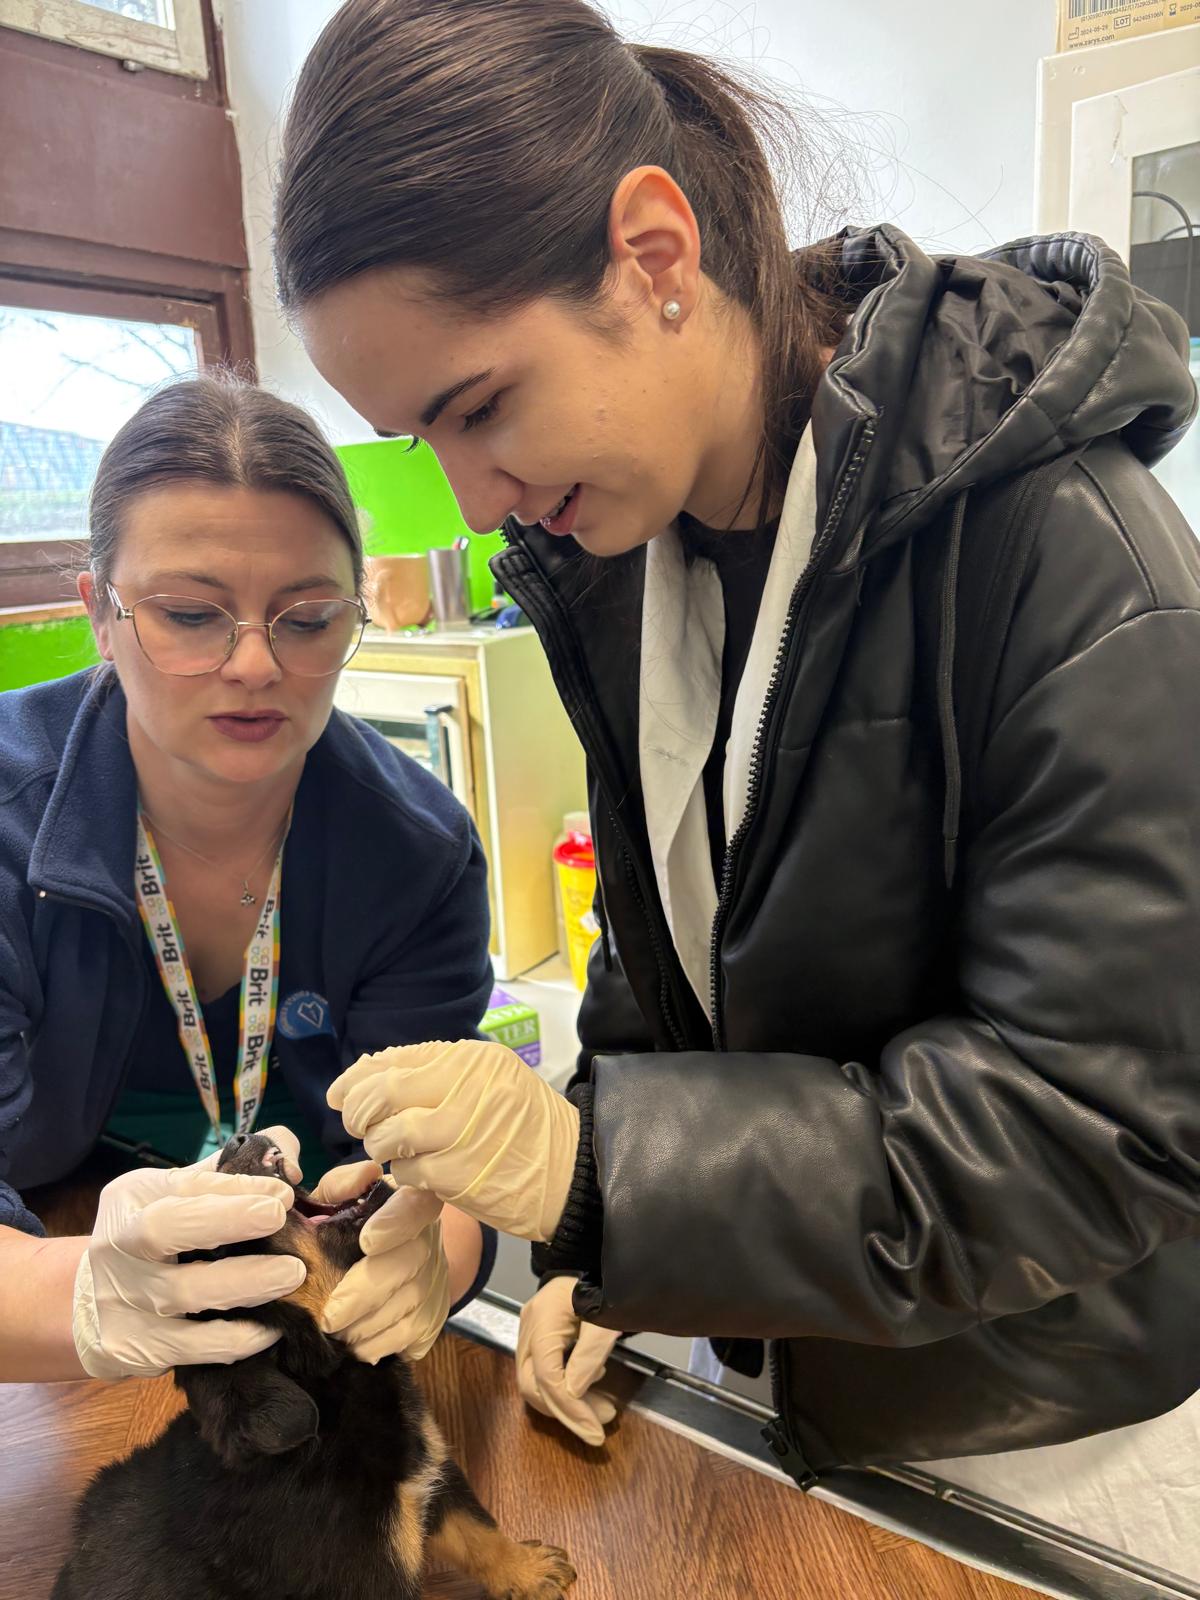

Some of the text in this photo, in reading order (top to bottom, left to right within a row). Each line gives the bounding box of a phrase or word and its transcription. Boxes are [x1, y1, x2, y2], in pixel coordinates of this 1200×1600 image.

[1115, 17, 1129, 26] LOT
[1069, 34, 1114, 48] www.zarys.com
[136, 854, 160, 896] Brit
[256, 899, 275, 939] Brit
[157, 922, 180, 962] Brit
[249, 968, 269, 1006] Brit
[177, 990, 196, 1027] Brit
[243, 1034, 264, 1073] Brit
[196, 1054, 211, 1091] Brit
[239, 1098, 256, 1134] Bri
